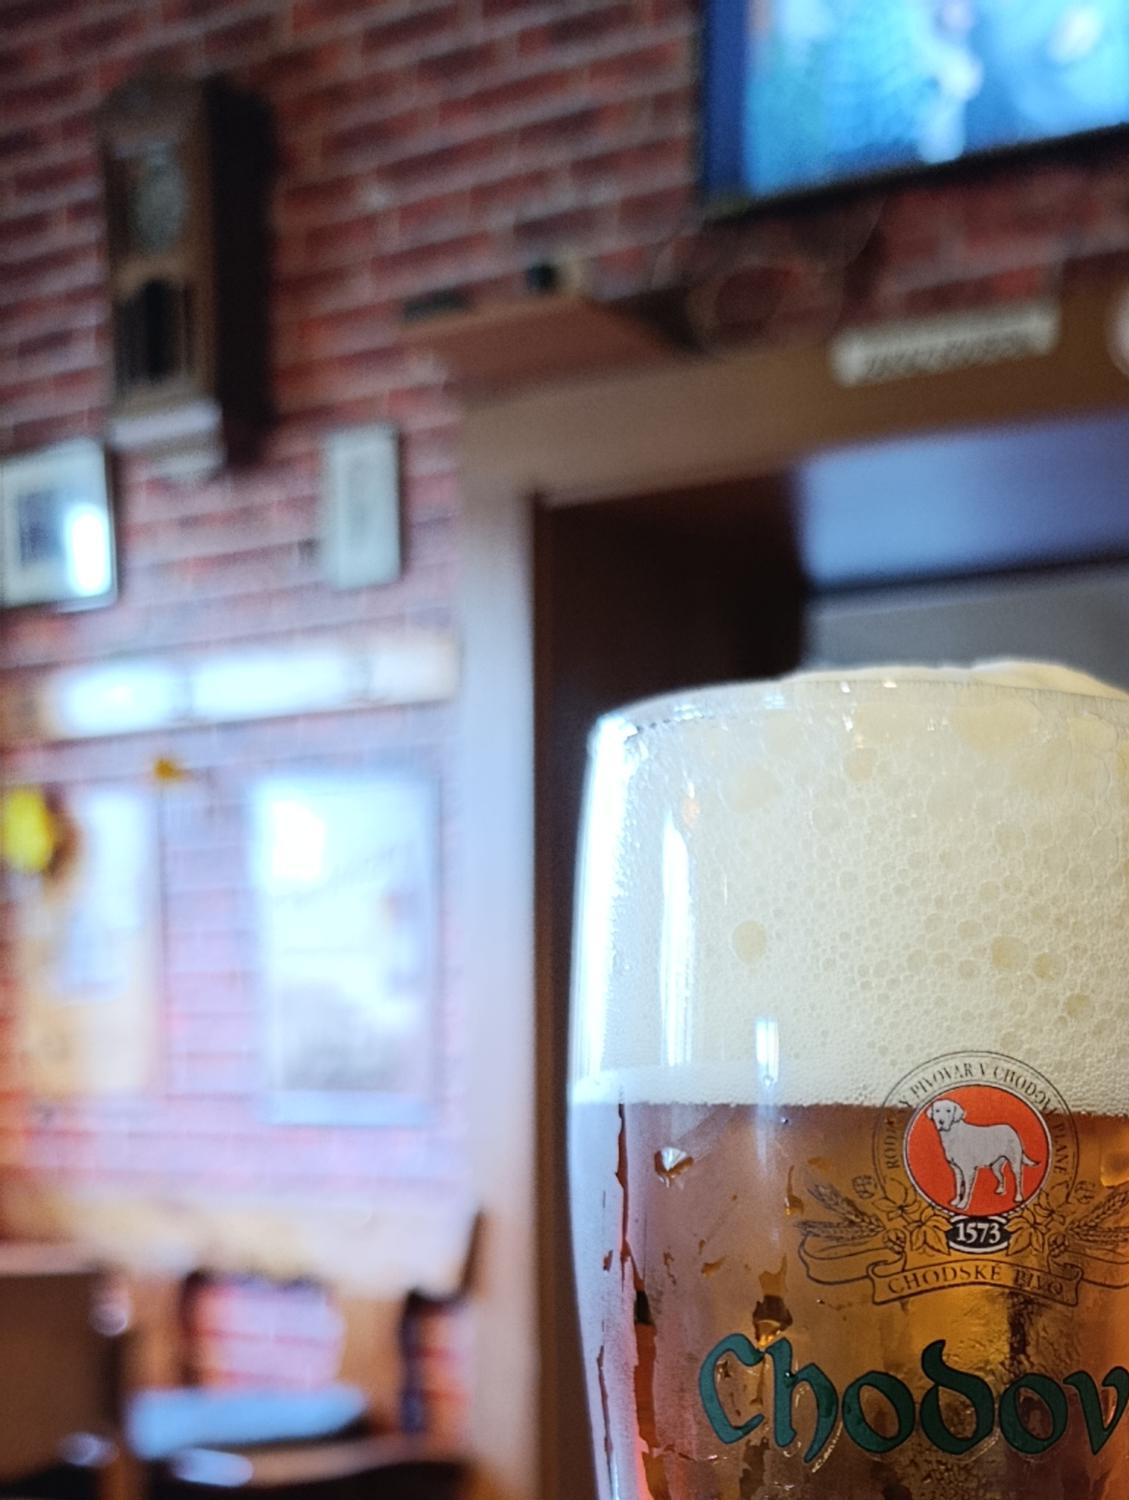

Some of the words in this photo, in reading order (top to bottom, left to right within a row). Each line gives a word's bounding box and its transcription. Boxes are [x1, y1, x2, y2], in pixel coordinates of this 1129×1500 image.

[910, 1063, 974, 1098] PIVOVAR
[993, 1065, 1061, 1118] CHODOV
[956, 1222, 1000, 1244] 1573
[1013, 1269, 1064, 1296] PIVO
